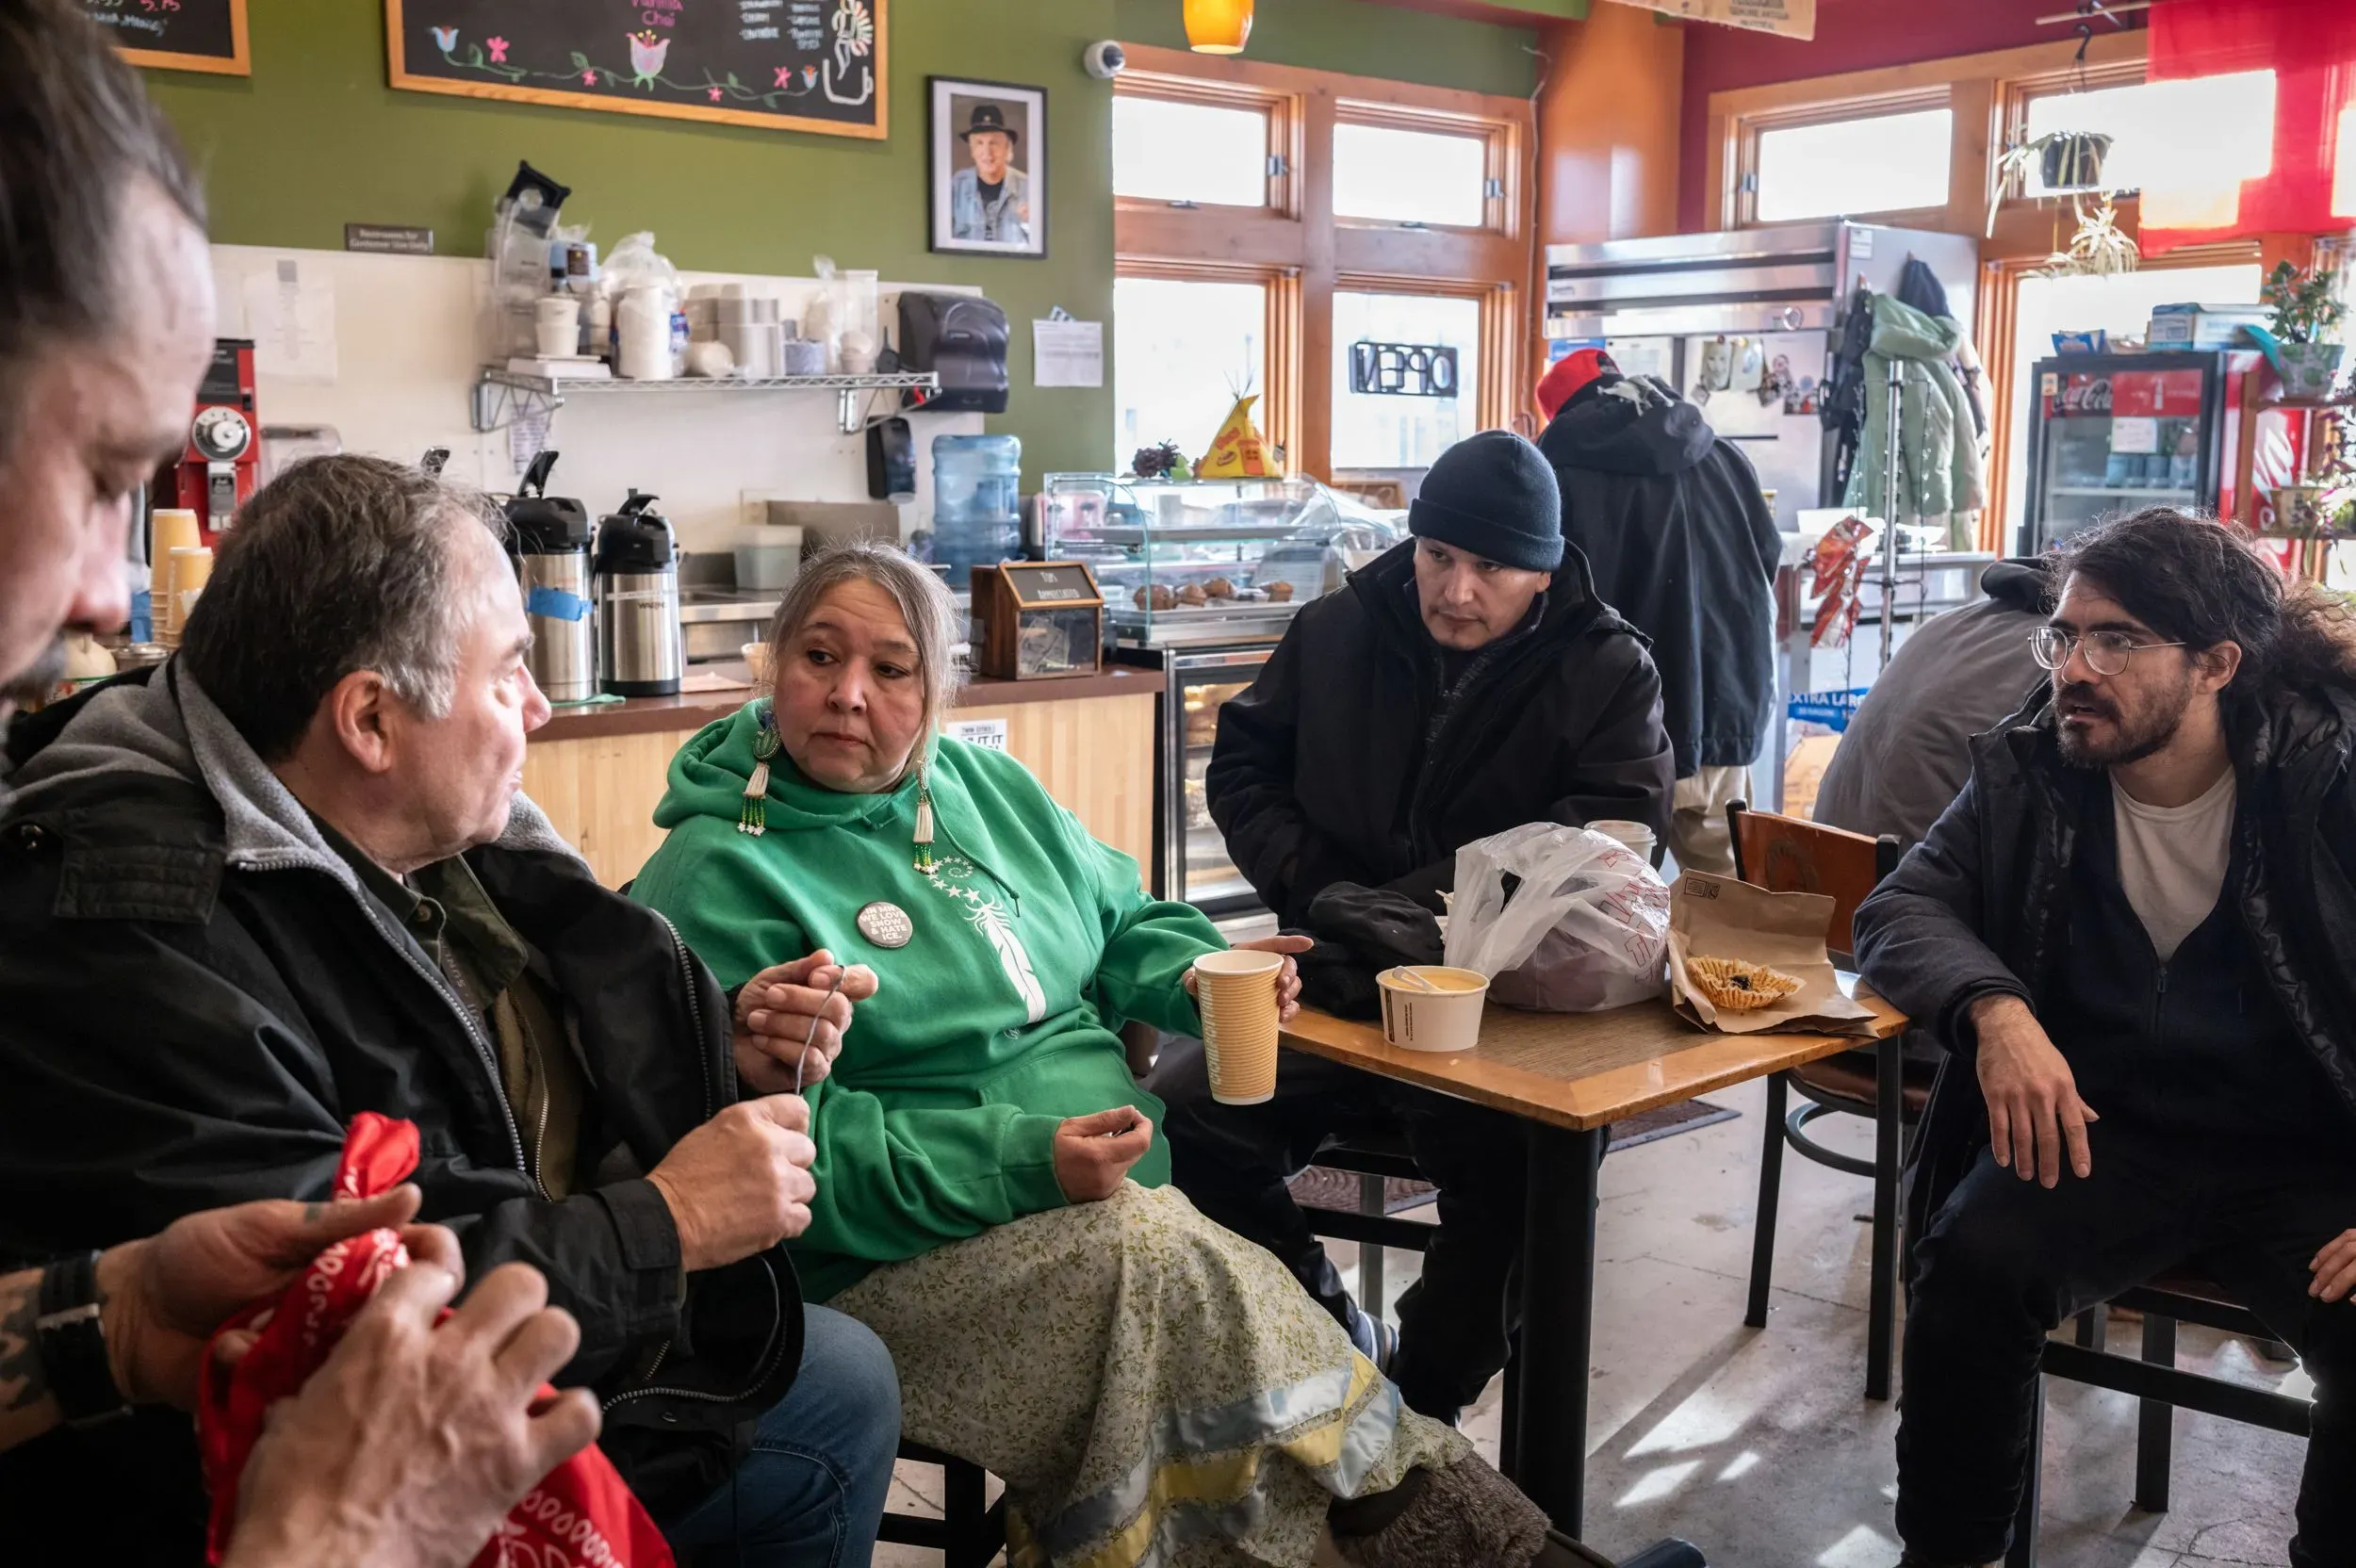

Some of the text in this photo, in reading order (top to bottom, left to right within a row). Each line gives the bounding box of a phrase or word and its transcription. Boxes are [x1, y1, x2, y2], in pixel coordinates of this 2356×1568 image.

[859, 910, 907, 923] WE LOVE
[869, 918, 902, 928] SNOW
[879, 923, 908, 934] HATE
